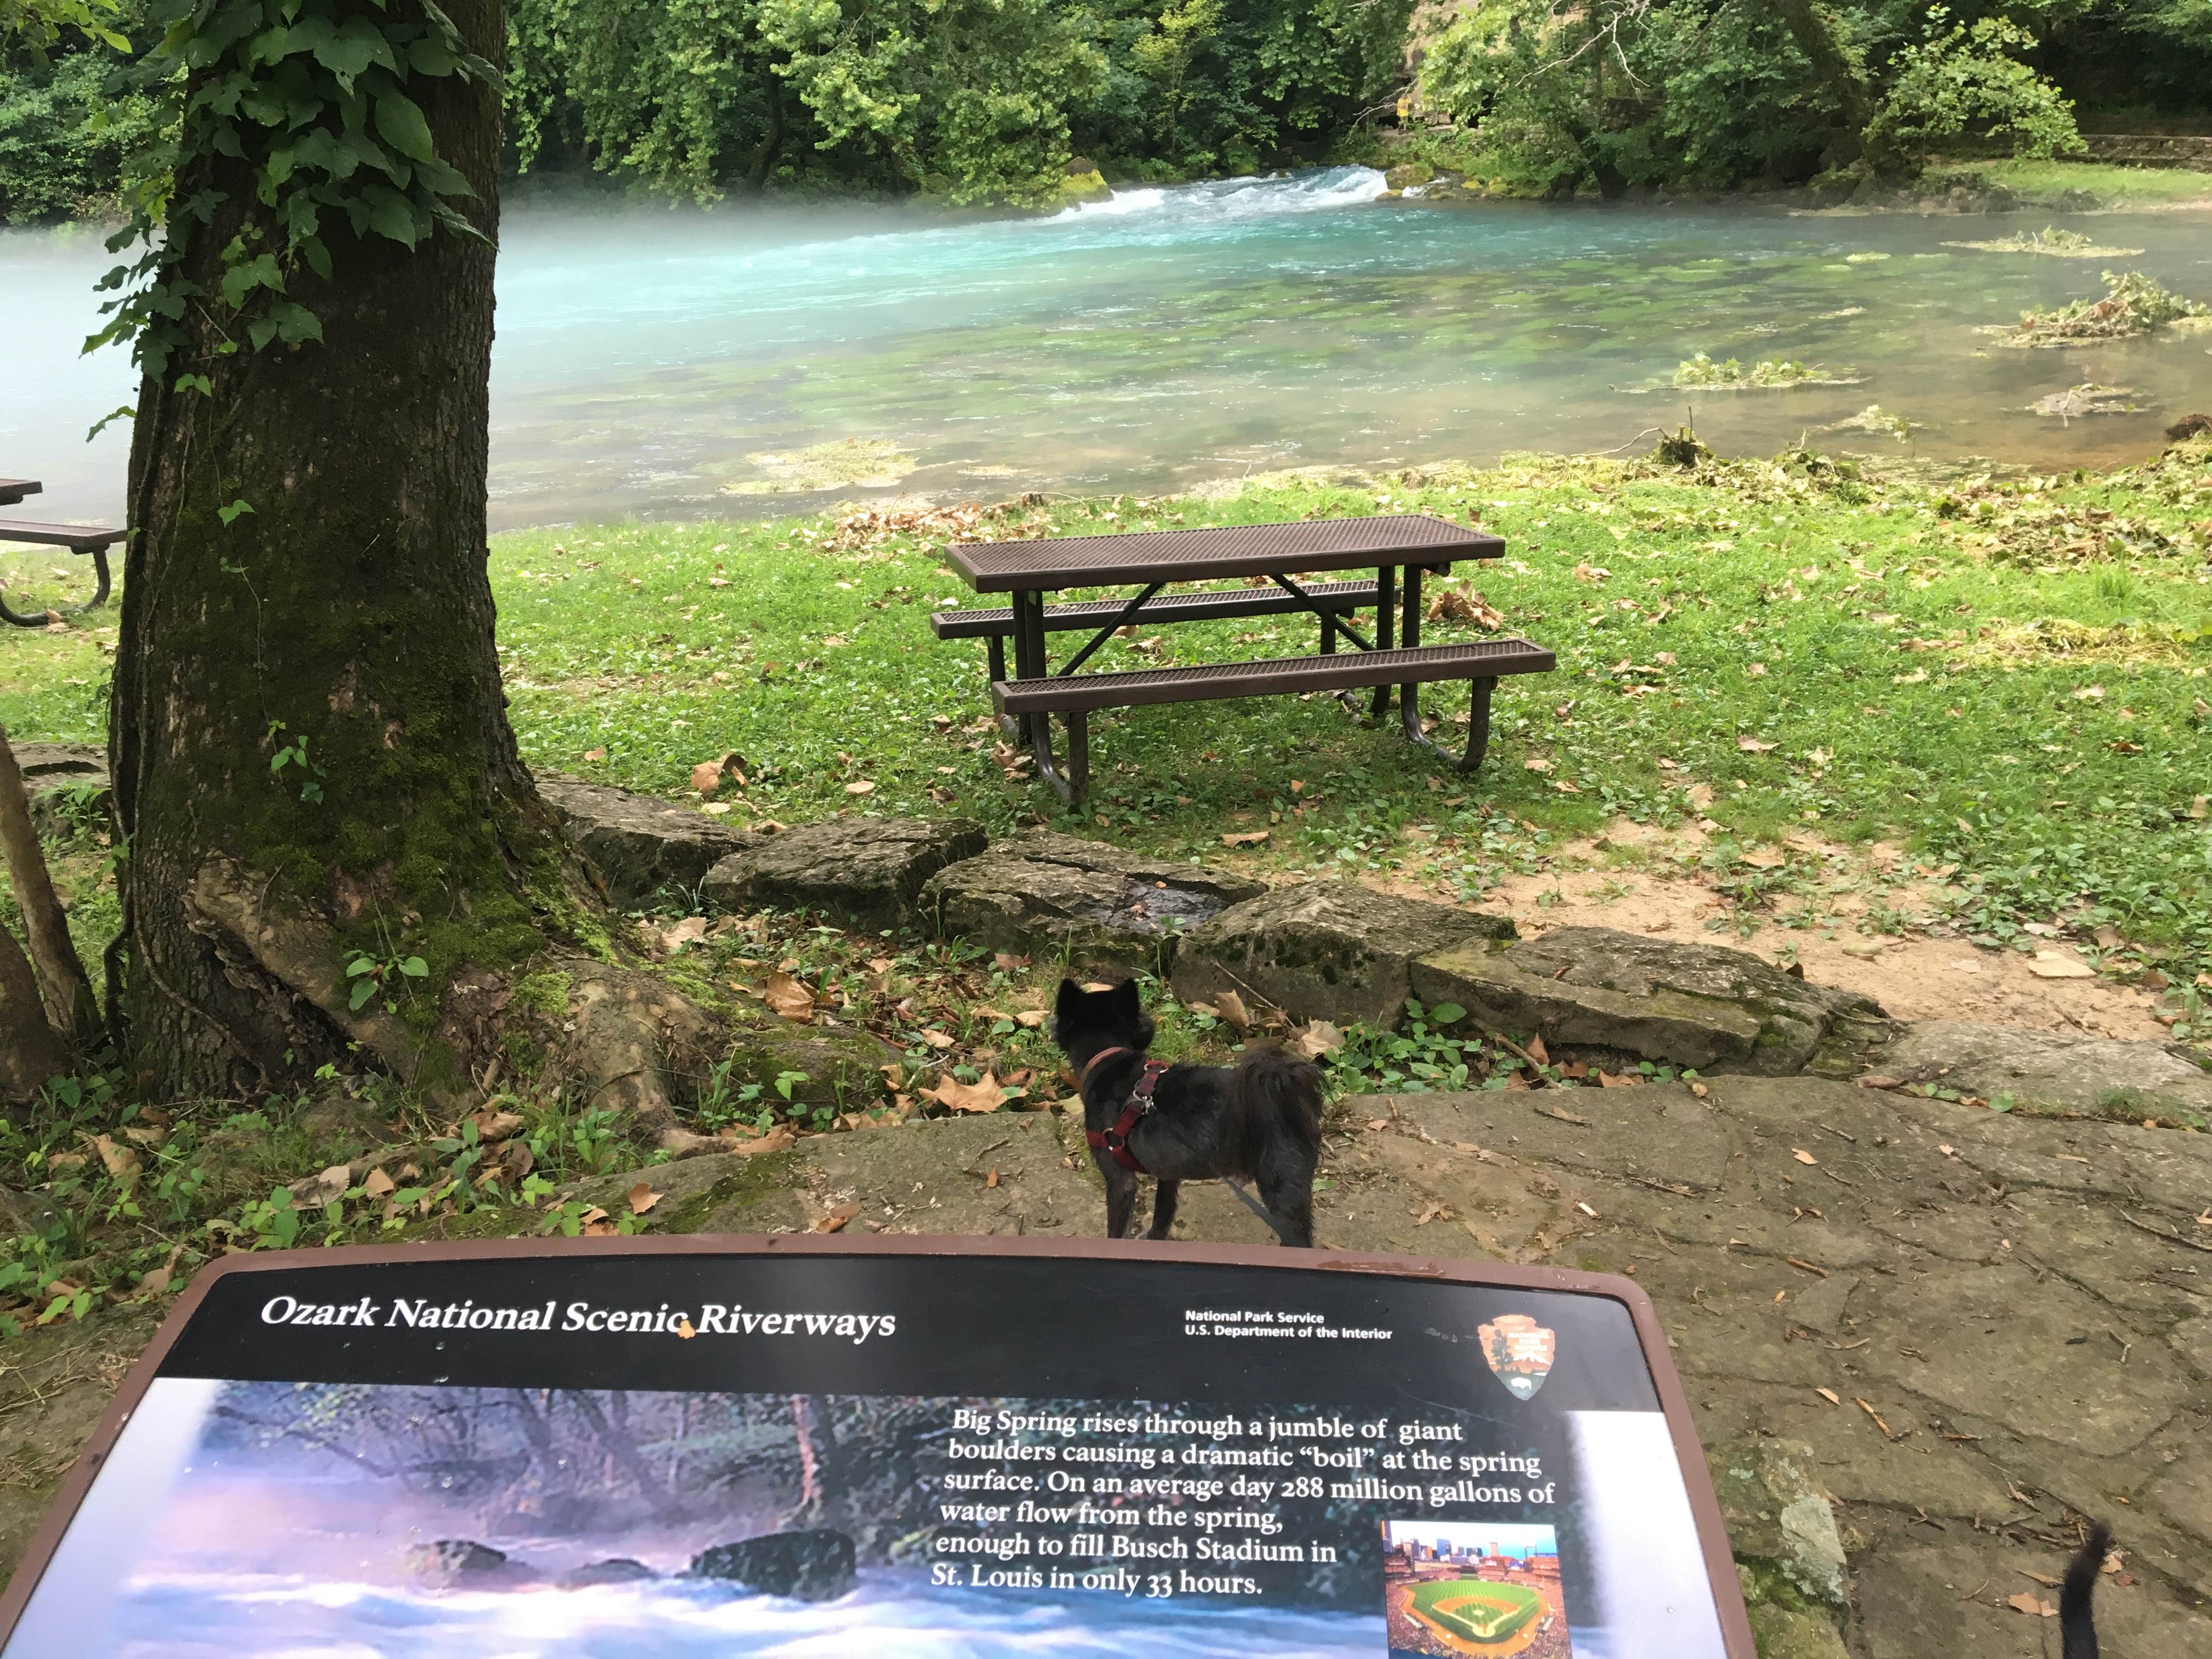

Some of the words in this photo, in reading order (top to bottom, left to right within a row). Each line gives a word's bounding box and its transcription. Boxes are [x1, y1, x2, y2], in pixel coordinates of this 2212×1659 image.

[261, 1296, 381, 1326] Ozark
[383, 1299, 556, 1330] National
[561, 1302, 689, 1334] Scenic
[695, 1305, 895, 1345] Riverways
[1185, 1324, 1211, 1336] U.S.
[1214, 1325, 1295, 1338] Department
[1297, 1326, 1313, 1338] of
[1316, 1327, 1339, 1338] the
[1342, 1327, 1393, 1339] Interior
[1186, 1310, 1242, 1322] National
[1245, 1311, 1274, 1322] Park
[1277, 1312, 1324, 1324] Service
[952, 1408, 992, 1436] Big
[996, 1410, 1077, 1437] Spring
[1082, 1412, 1140, 1433] rises
[1144, 1412, 1243, 1440] through
[1249, 1421, 1263, 1436] a
[1268, 1416, 1354, 1442] jumble
[1361, 1418, 1388, 1438] of
[1399, 1419, 1463, 1446] giant
[949, 1438, 1056, 1460] boulders
[1063, 1442, 1156, 1469] causing
[1161, 1449, 1175, 1464] a
[1181, 1443, 1294, 1466] dramatic
[1382, 1451, 1407, 1469] at
[1411, 1449, 1452, 1470] the
[1459, 1451, 1542, 1479] spring
[944, 1468, 1040, 1491] surface.
[1047, 1470, 1086, 1492] On
[1092, 1477, 1123, 1493] an
[1127, 1479, 1223, 1502] average
[1230, 1475, 1276, 1503] day
[1281, 1476, 1324, 1498] 288
[1330, 1477, 1424, 1500] million
[1430, 1480, 1522, 1508] gallons
[1528, 1482, 1556, 1504] of
[940, 1503, 1011, 1523] water
[1015, 1500, 1074, 1523] flow
[1077, 1501, 1140, 1525] from
[1147, 1504, 1187, 1526] the
[1194, 1506, 1283, 1535] spring,
[935, 1532, 1030, 1561] enough
[1038, 1536, 1063, 1555] to
[1069, 1533, 1104, 1556] fill
[1110, 1535, 1189, 1559] Busch
[1196, 1537, 1305, 1562] Stadium
[1311, 1540, 1338, 1562] in
[931, 1562, 963, 1586] St.
[969, 1564, 1043, 1588] Louis
[1049, 1566, 1076, 1589] in
[1082, 1567, 1141, 1598] only
[1146, 1574, 1172, 1598] 33
[1180, 1569, 1262, 1594] hours.
